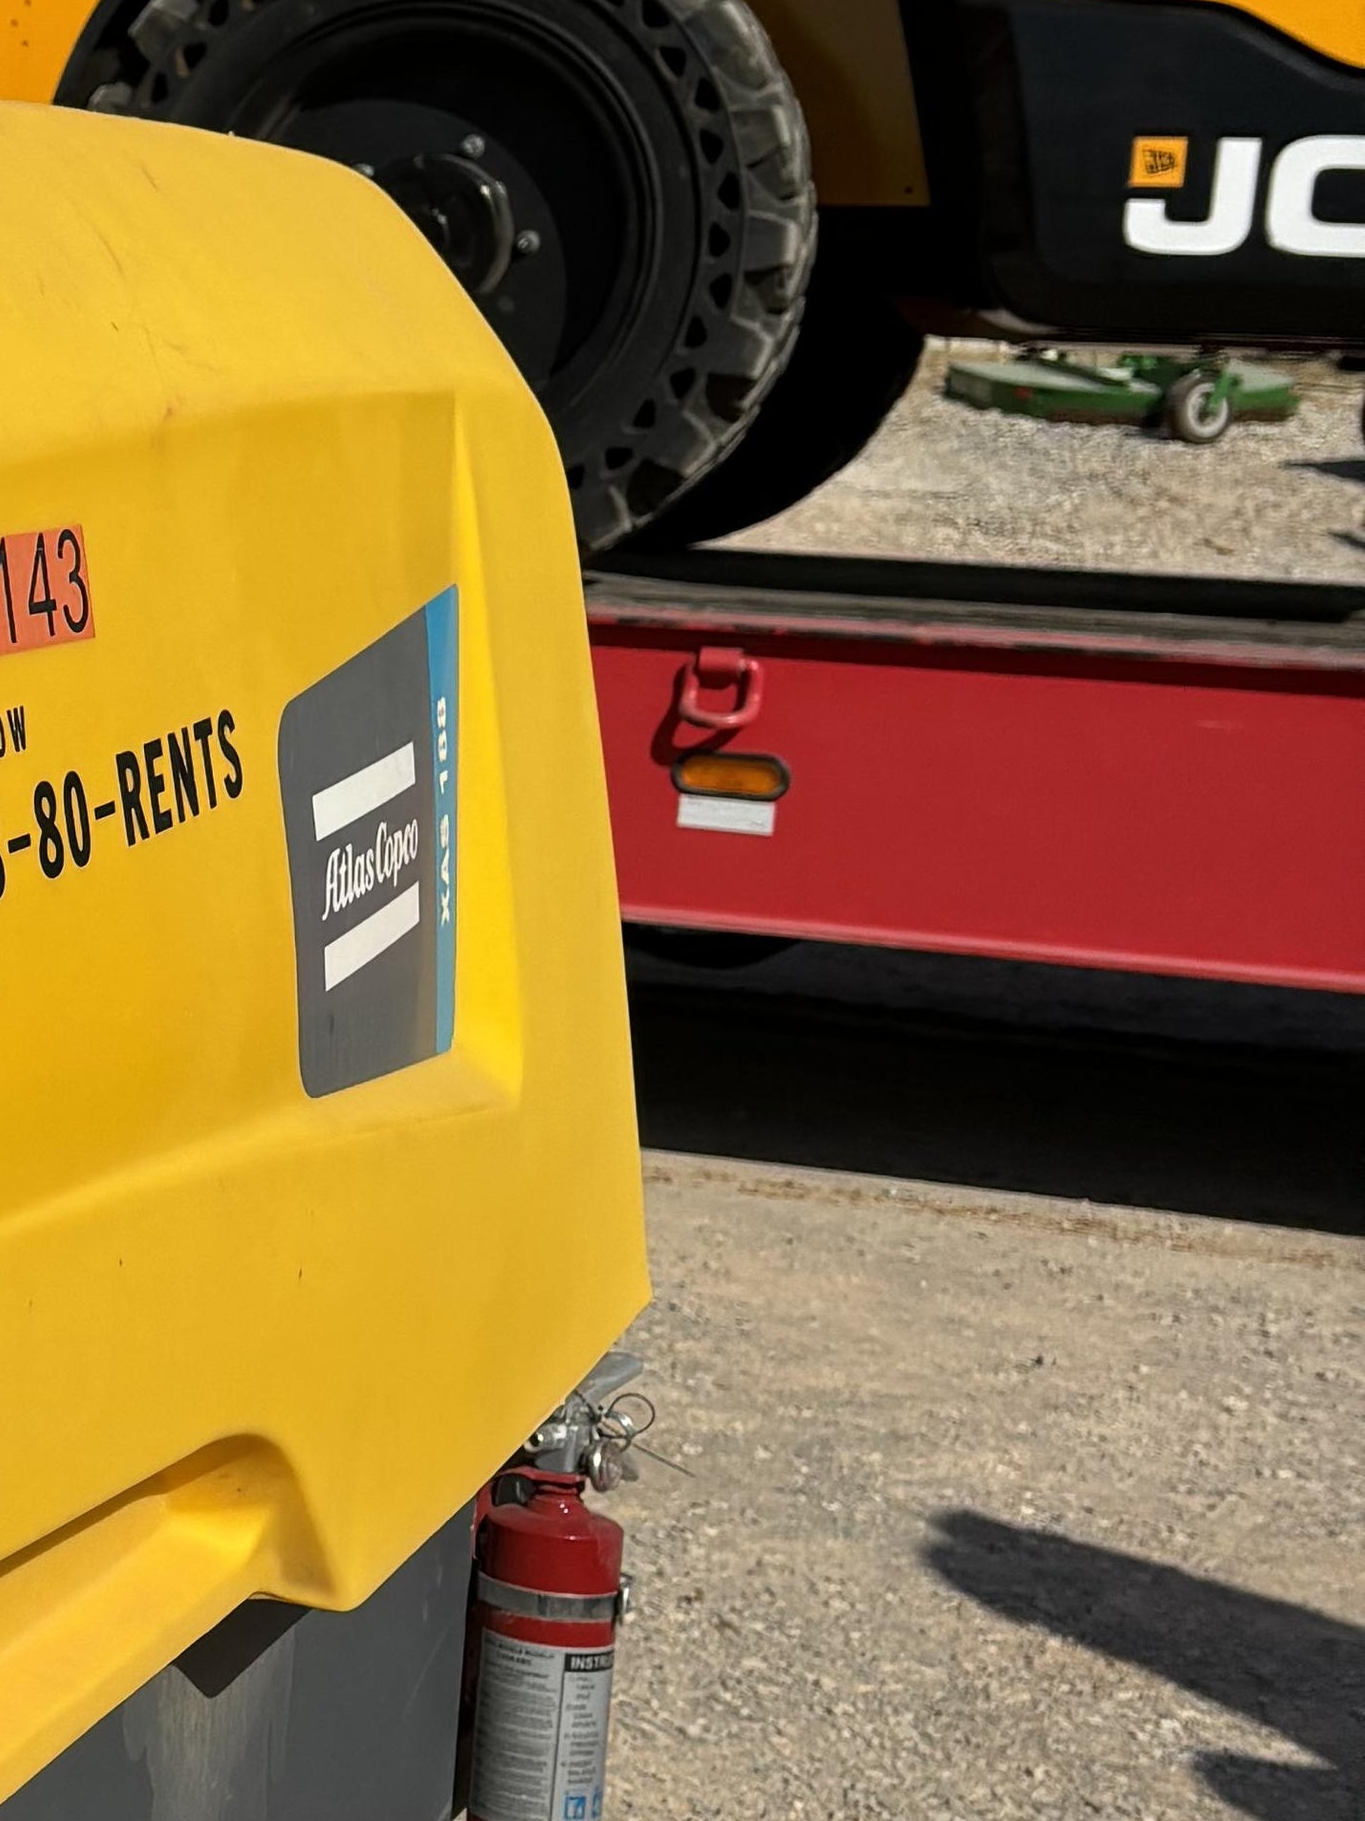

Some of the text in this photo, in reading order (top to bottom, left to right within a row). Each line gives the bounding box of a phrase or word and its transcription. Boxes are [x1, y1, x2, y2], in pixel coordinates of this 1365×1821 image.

[321, 817, 419, 921] Atlas Copco
[436, 696, 451, 926] XAS 188
